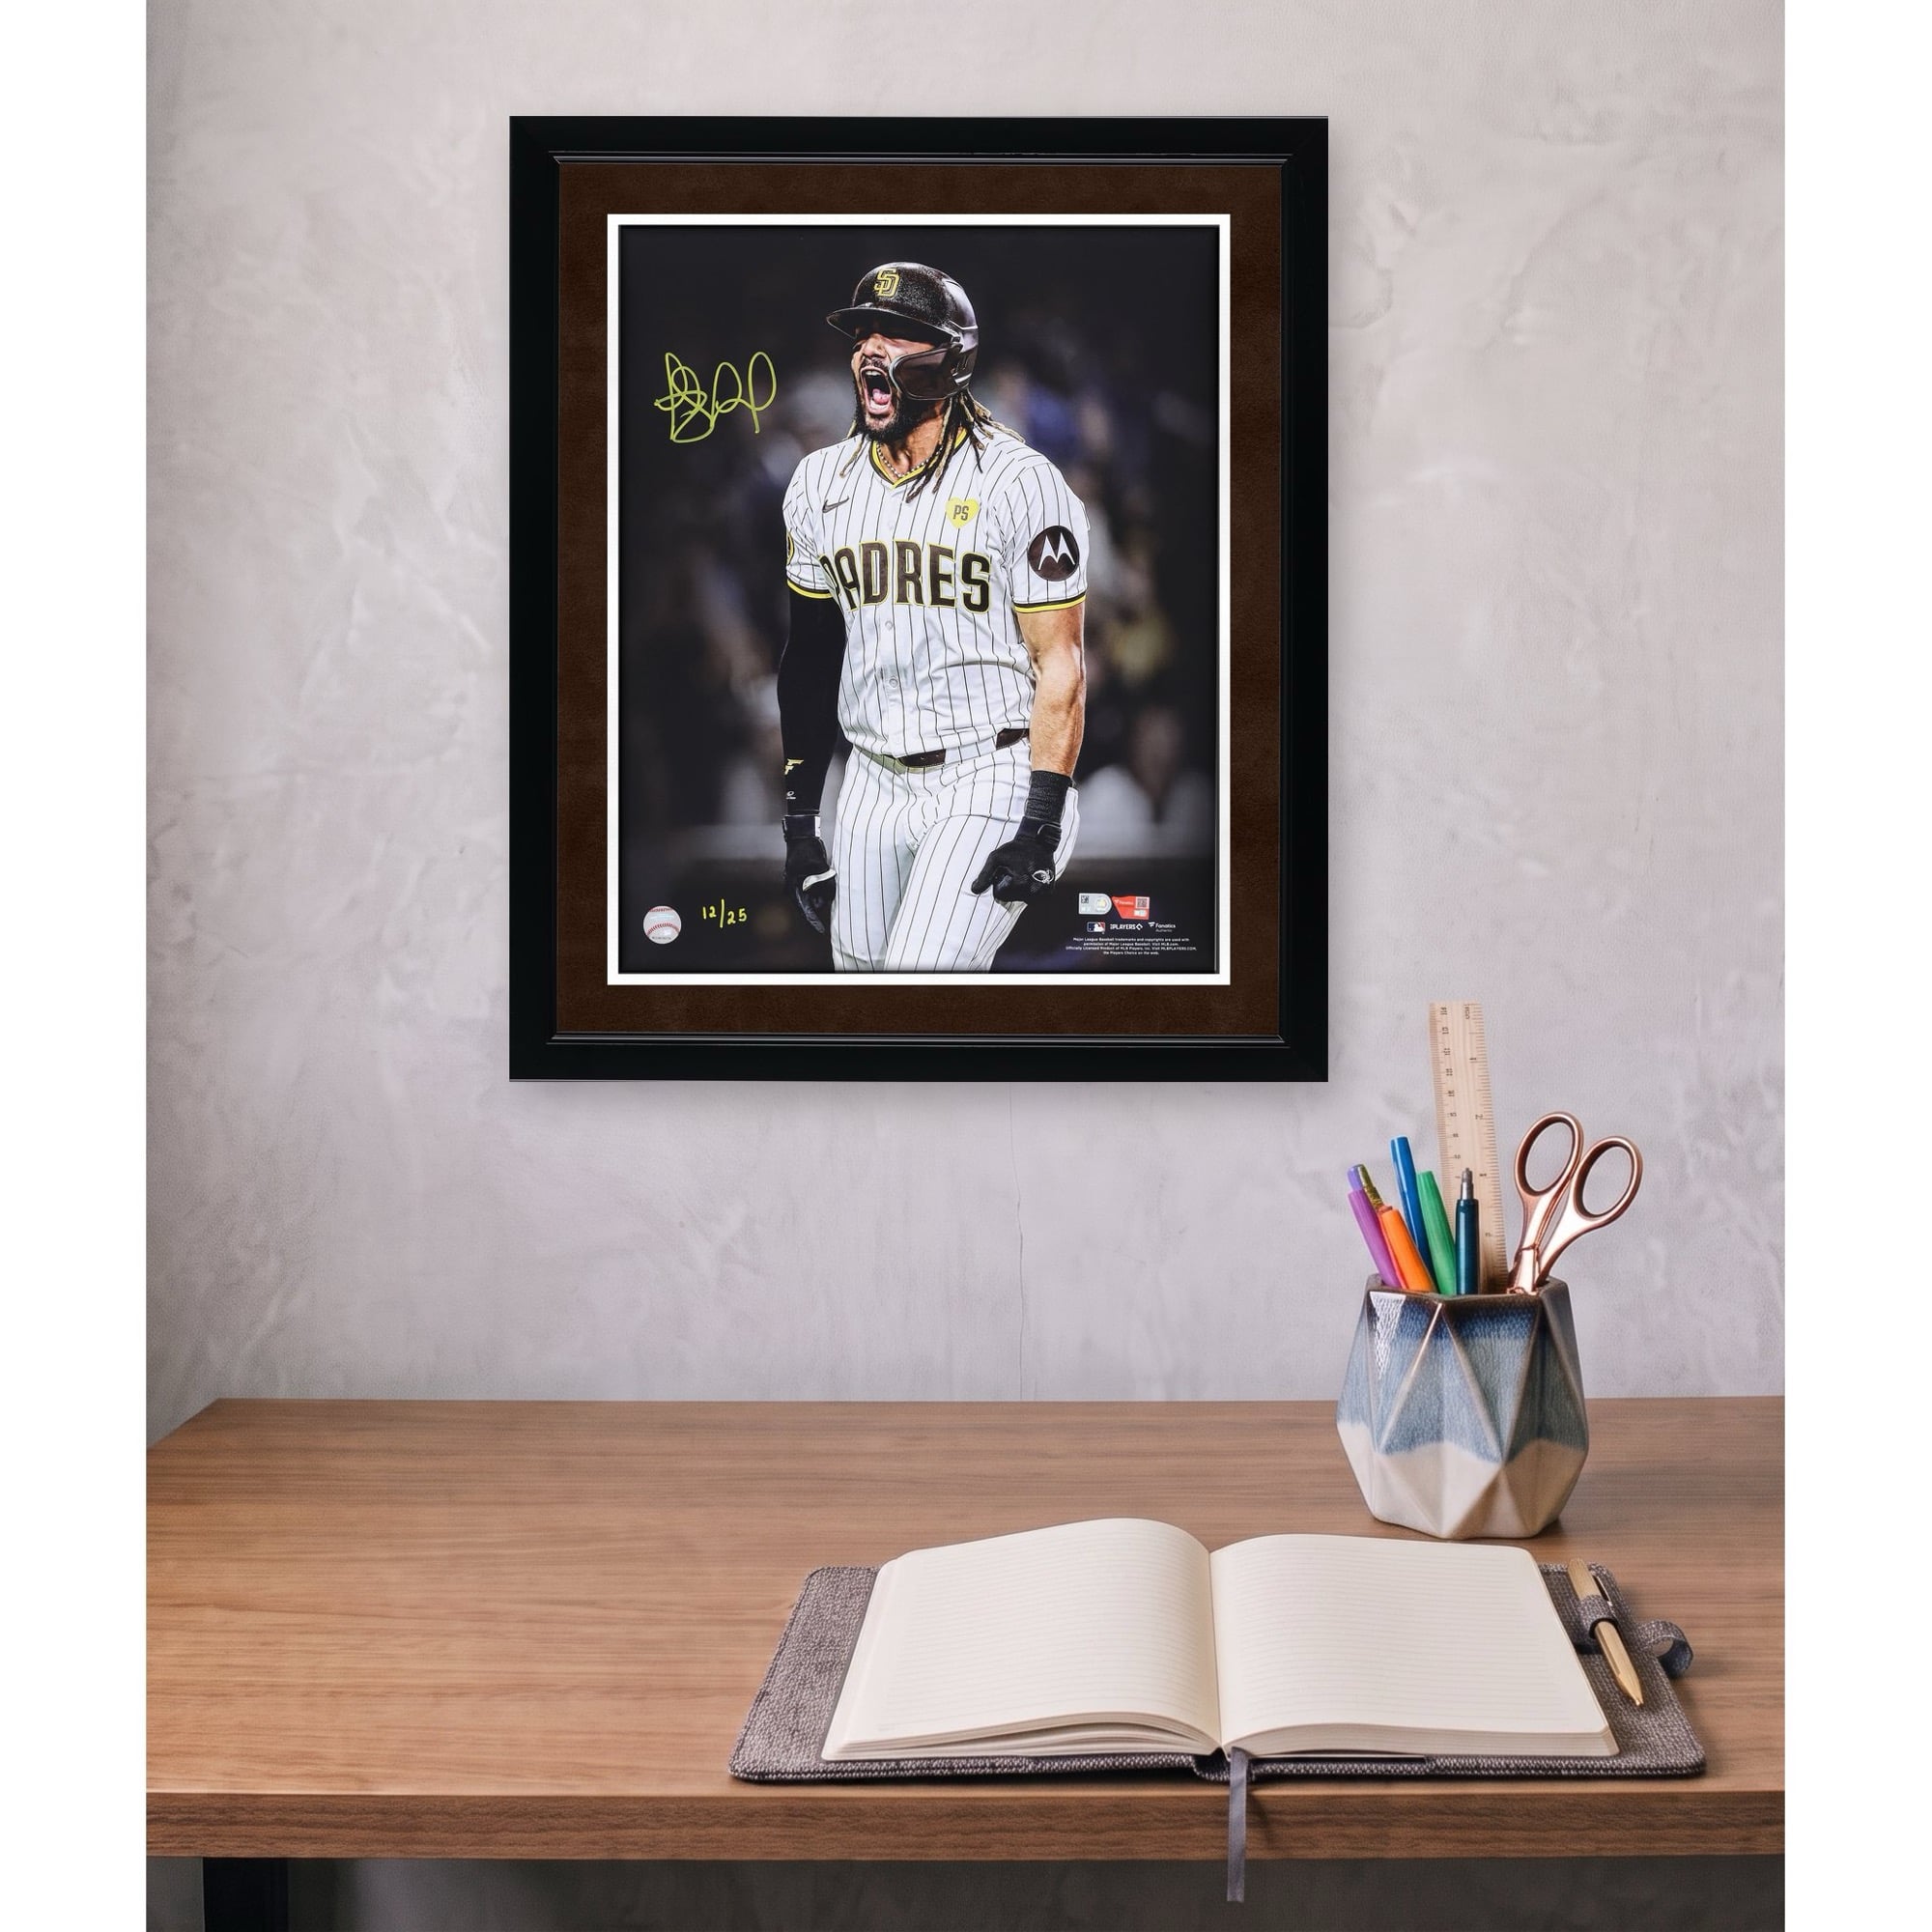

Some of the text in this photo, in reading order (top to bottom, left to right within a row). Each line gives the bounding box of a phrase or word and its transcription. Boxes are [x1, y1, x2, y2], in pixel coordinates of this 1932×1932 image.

[952, 504, 969, 521] PS
[819, 539, 991, 613] PADRES
[702, 898, 748, 928] 12/25
